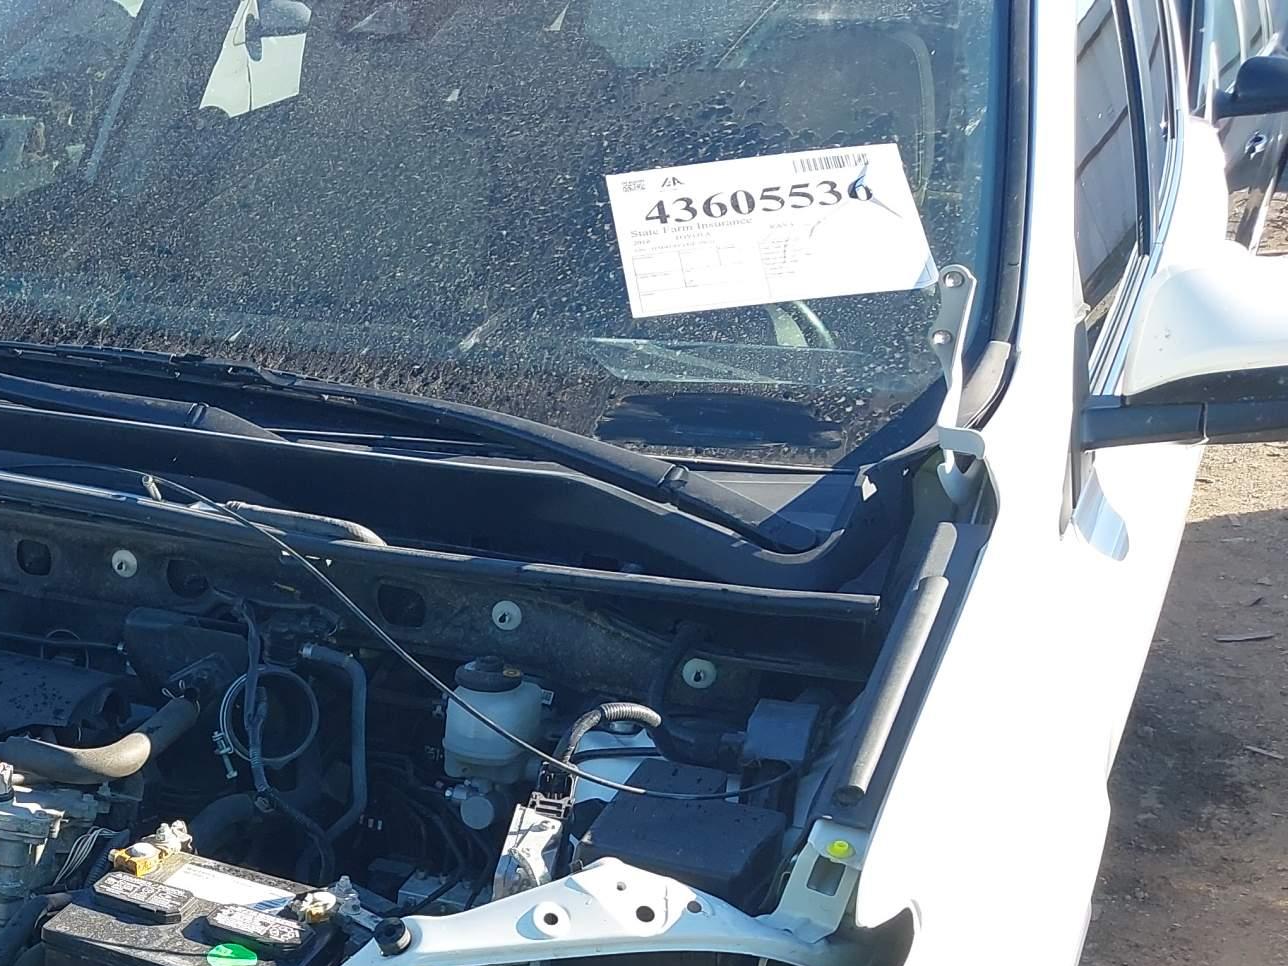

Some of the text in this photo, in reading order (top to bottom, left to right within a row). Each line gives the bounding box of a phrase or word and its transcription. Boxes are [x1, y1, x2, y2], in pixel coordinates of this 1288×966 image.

[644, 178, 873, 225] 43605536
[630, 217, 753, 239] State Farm Insurance
